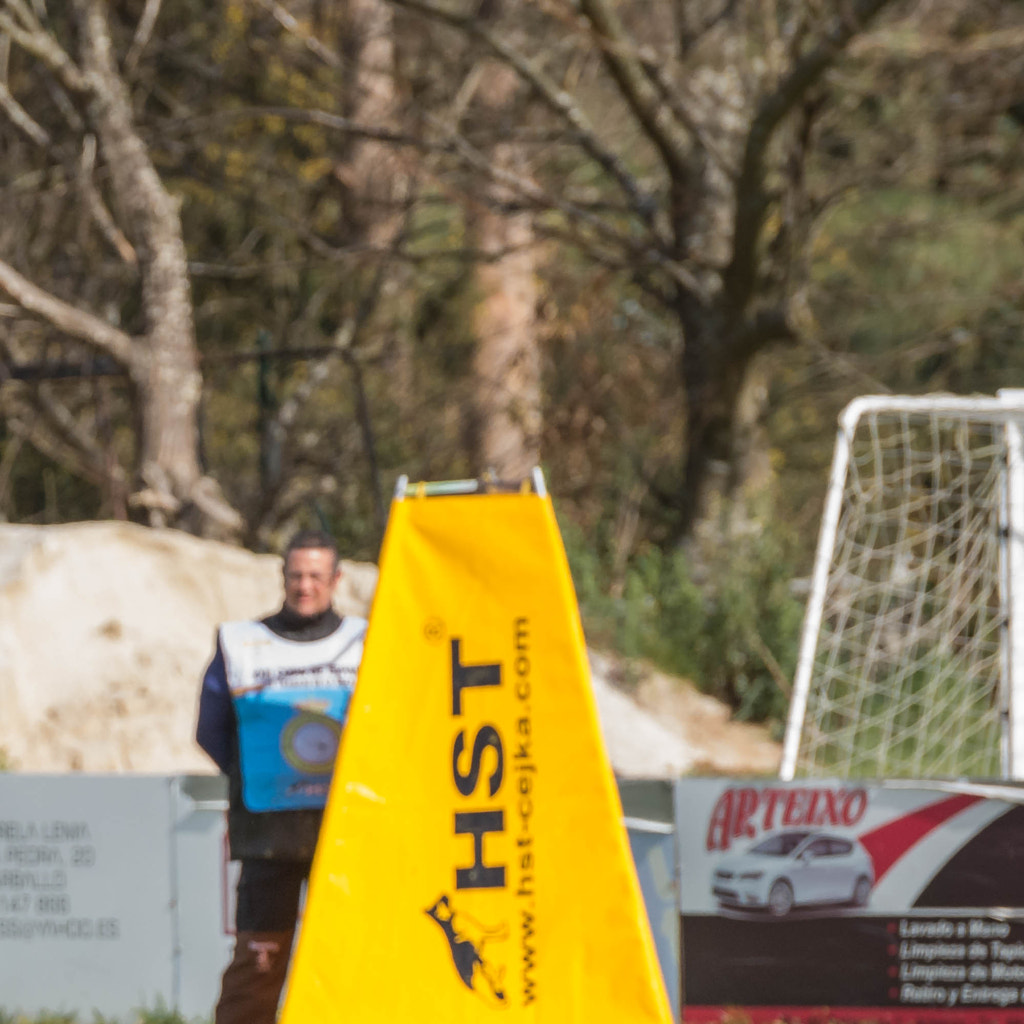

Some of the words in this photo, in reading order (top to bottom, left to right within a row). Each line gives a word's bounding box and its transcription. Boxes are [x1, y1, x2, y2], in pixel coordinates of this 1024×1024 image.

[450, 638, 505, 890] HST
[514, 616, 536, 1006] www.hst-cejka.com
[705, 788, 869, 852] ARTEIXO
